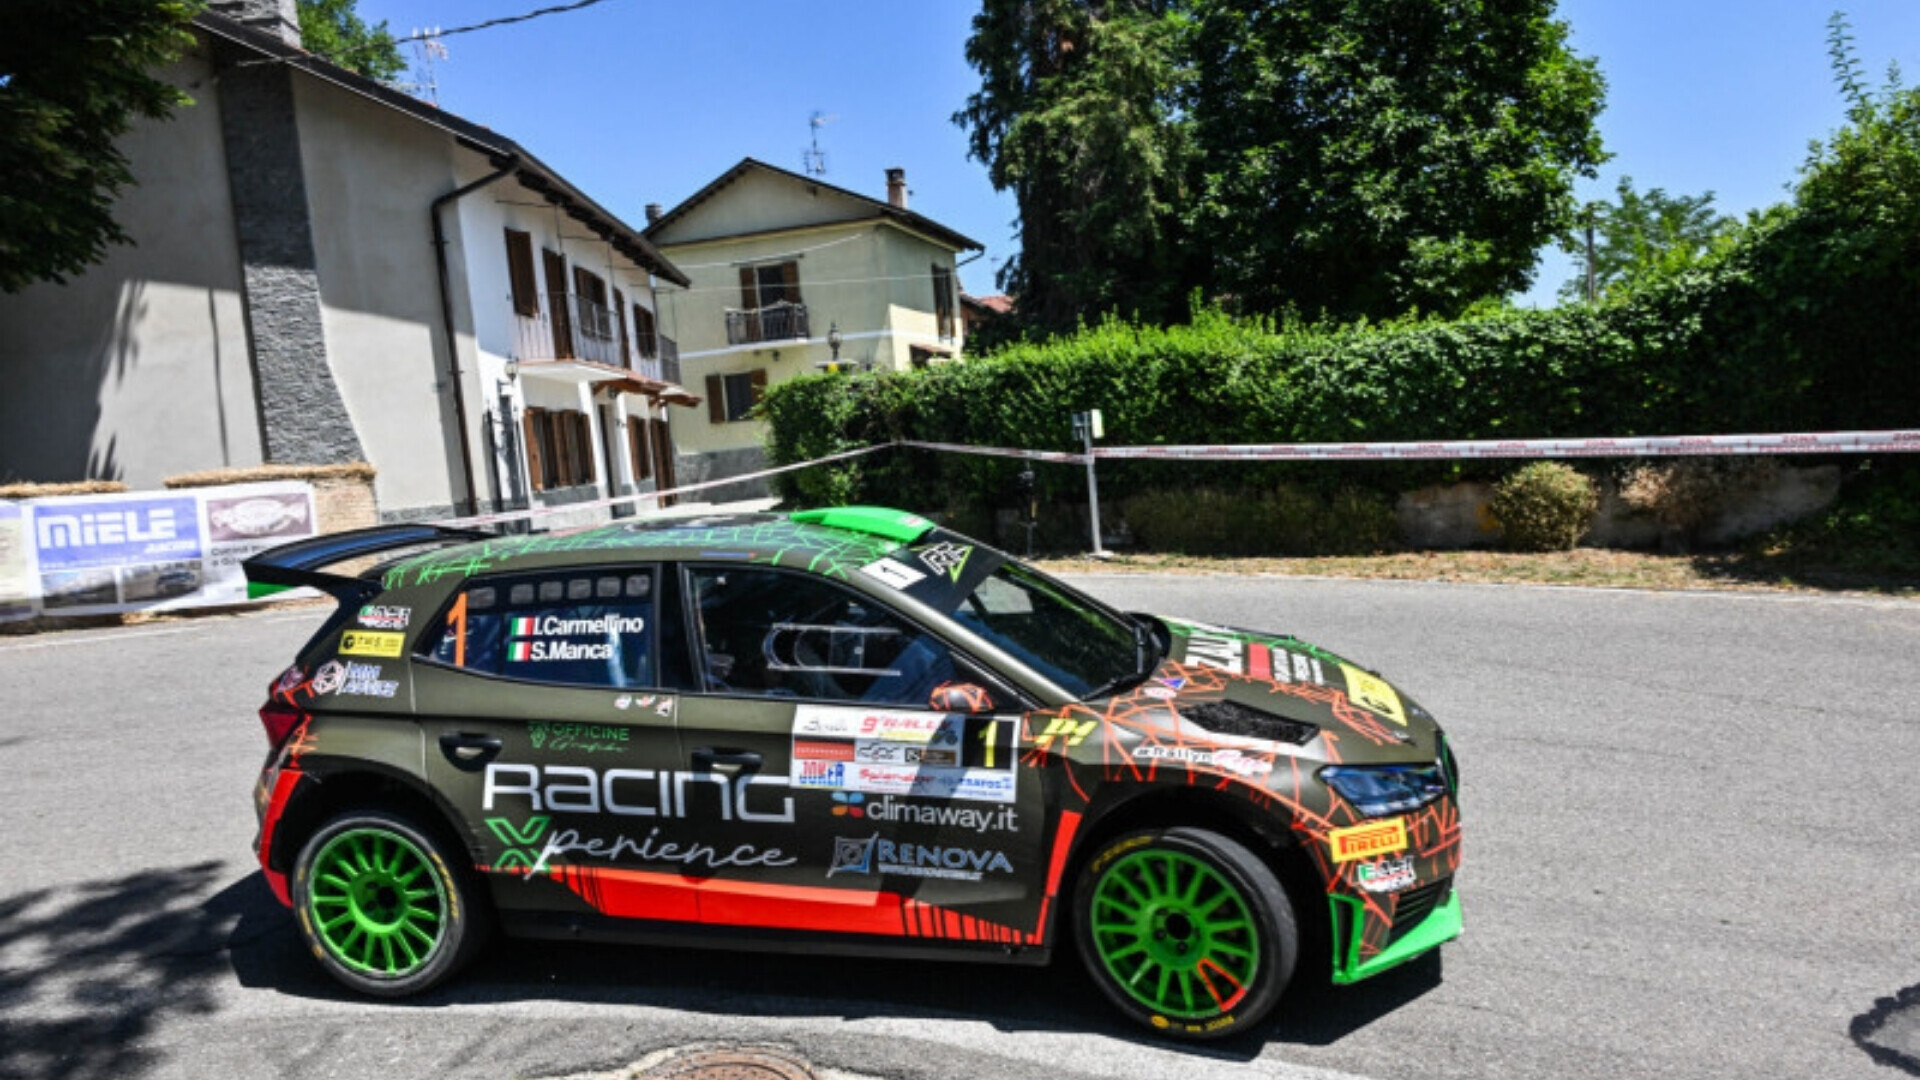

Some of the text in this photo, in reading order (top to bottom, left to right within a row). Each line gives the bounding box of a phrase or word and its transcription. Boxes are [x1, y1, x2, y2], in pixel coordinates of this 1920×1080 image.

[447, 591, 469, 668] 1
[530, 641, 613, 661] S.Manca
[552, 722, 630, 742] OFFICINE
[973, 720, 998, 768] 1
[866, 795, 1019, 832] climaway.it
[877, 838, 1015, 873] RENOVA
[1338, 826, 1401, 854] PIRELLI
